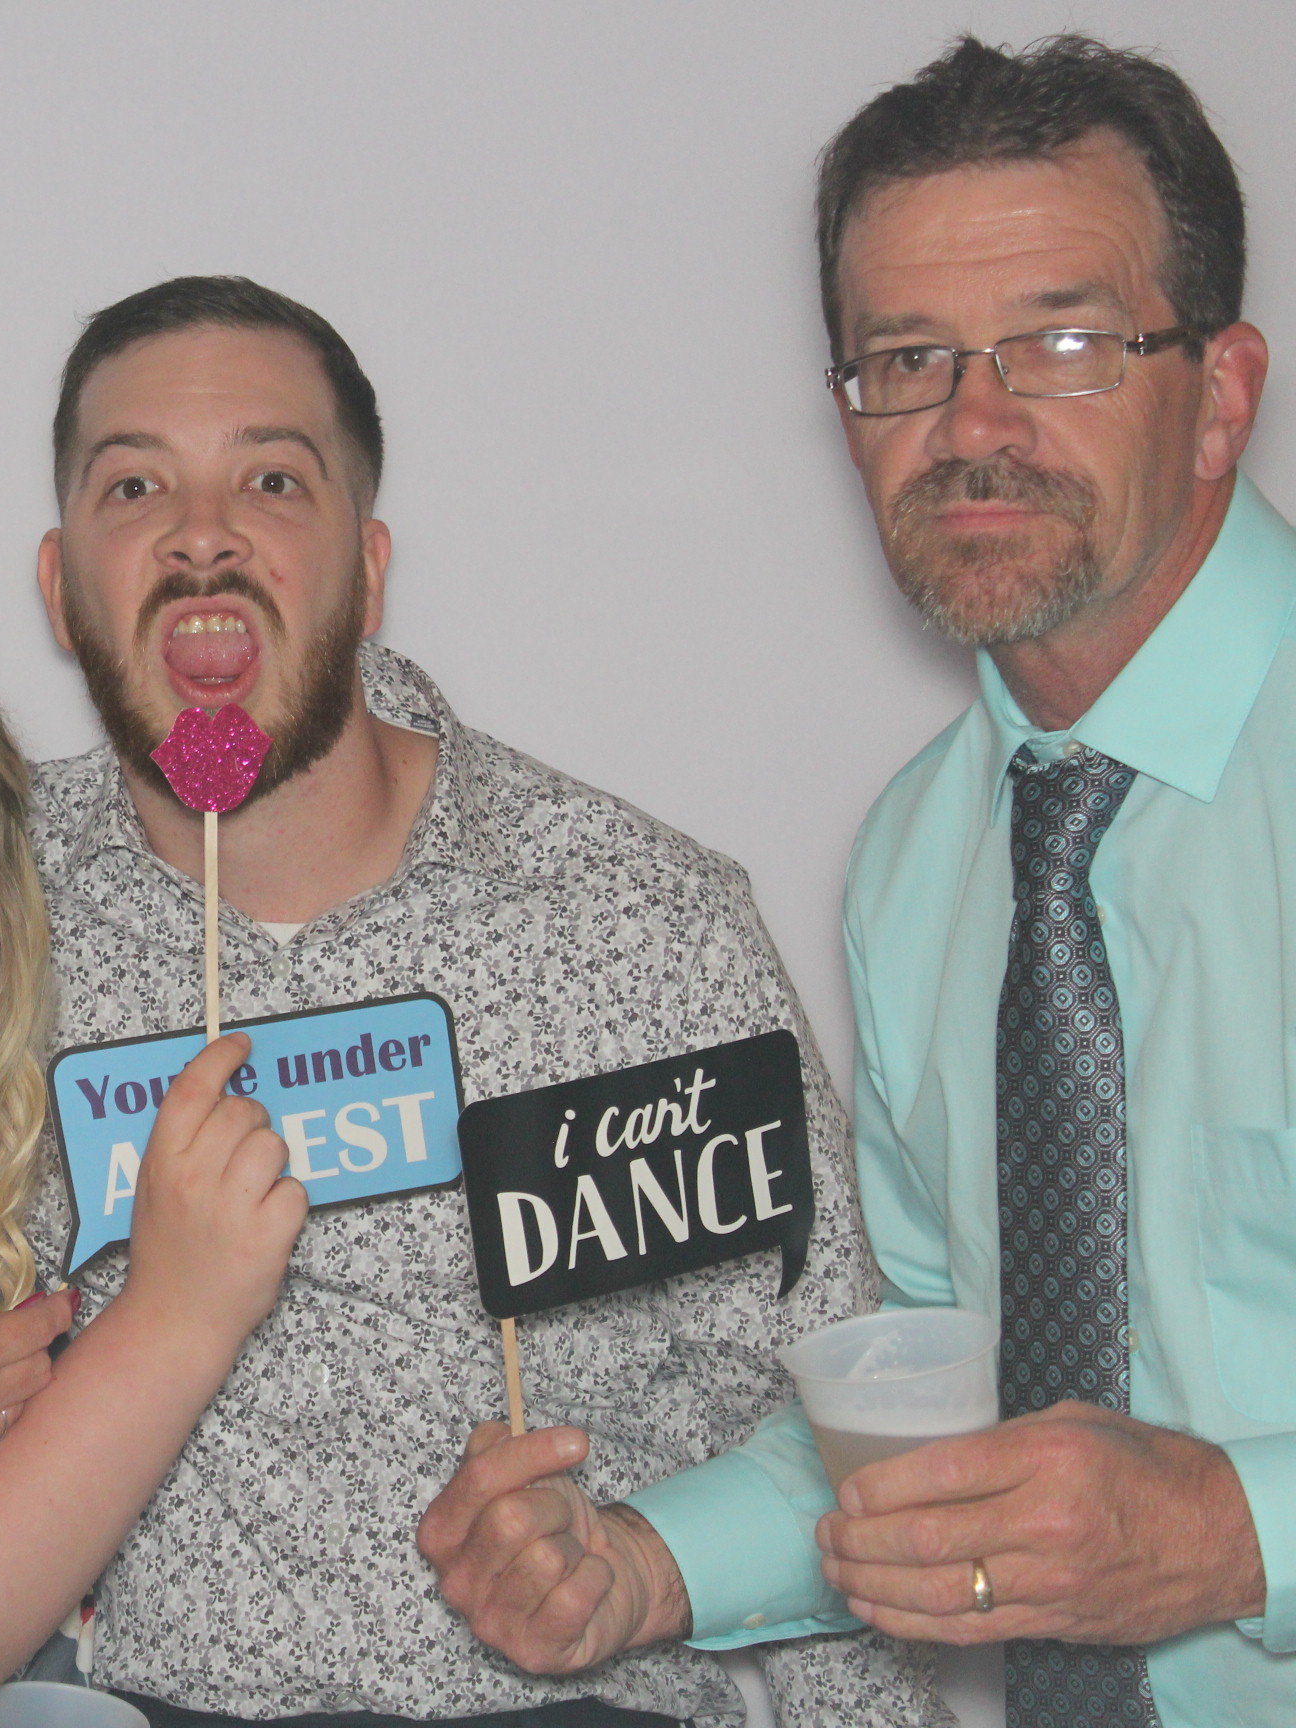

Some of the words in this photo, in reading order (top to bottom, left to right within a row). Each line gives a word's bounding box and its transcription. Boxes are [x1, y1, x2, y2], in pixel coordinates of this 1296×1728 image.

[276, 1032, 431, 1088] under
[103, 1091, 436, 1216] AEST
[554, 1109, 577, 1169] i
[595, 1068, 717, 1158] can't
[496, 1119, 793, 1287] DANCE
